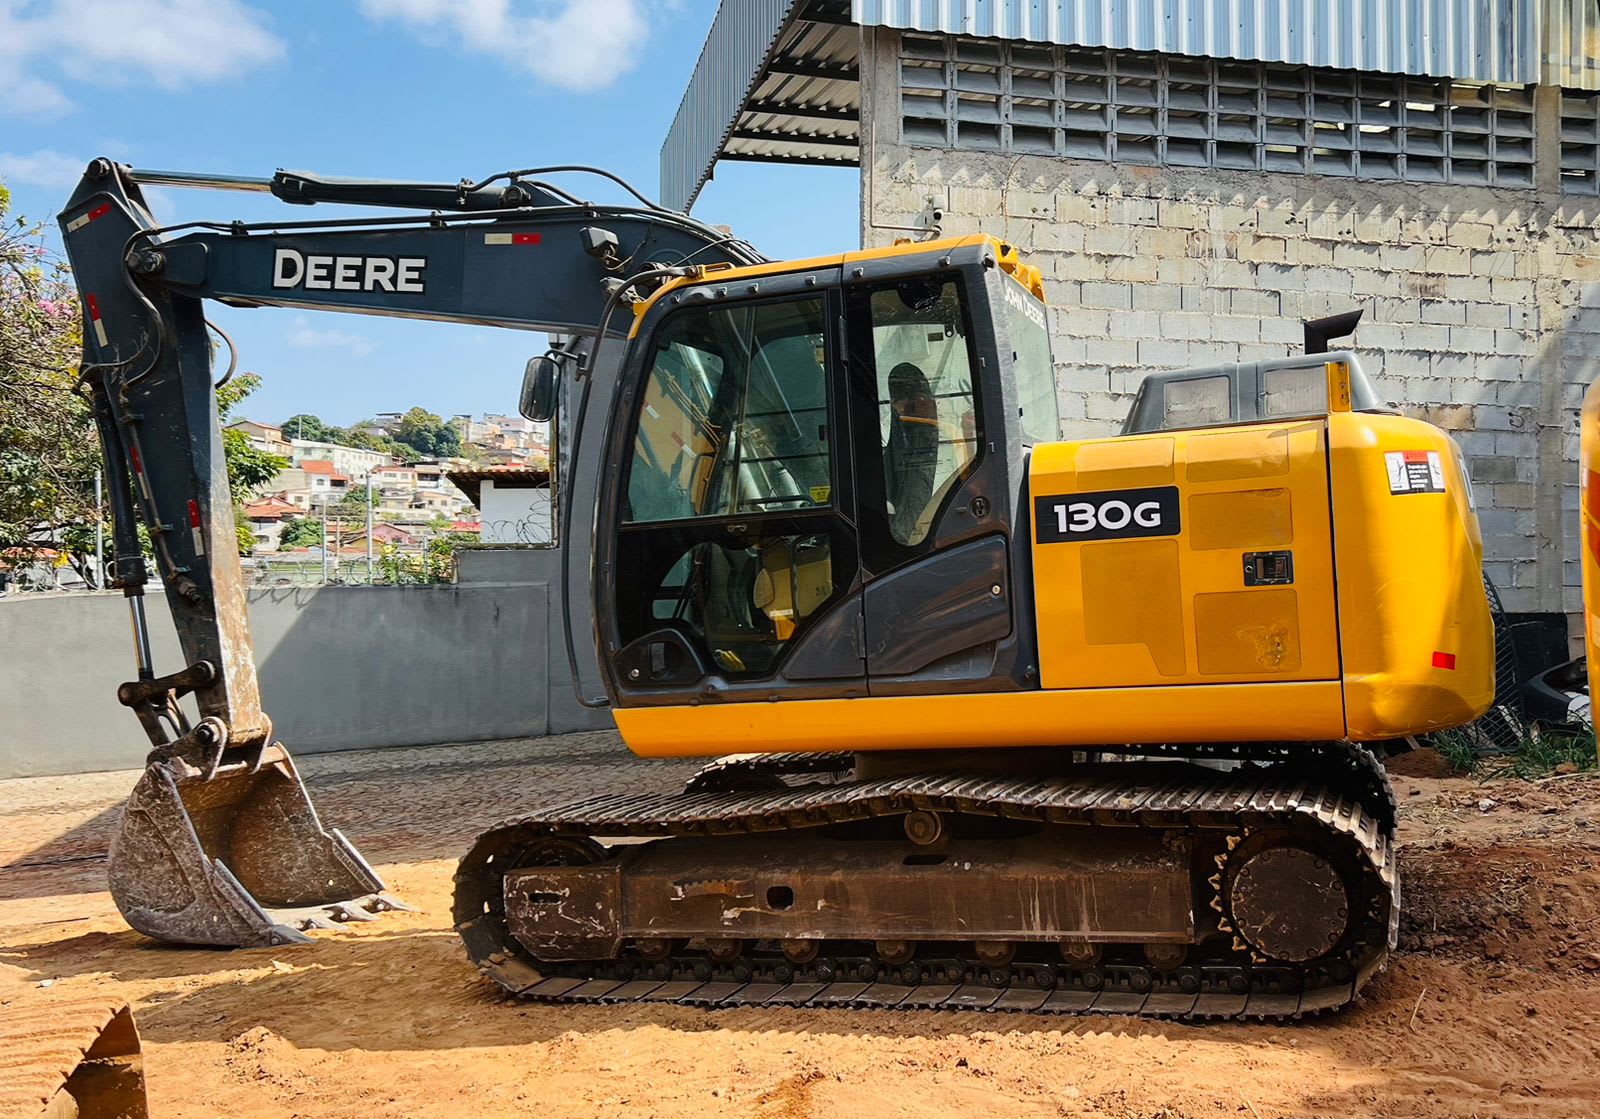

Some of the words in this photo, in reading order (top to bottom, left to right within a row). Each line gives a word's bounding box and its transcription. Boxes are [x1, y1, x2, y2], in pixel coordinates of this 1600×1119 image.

[273, 249, 425, 292] DEERE
[1004, 279, 1024, 313] JOHN
[1023, 294, 1045, 330] DEERE
[1053, 500, 1161, 533] 130G
